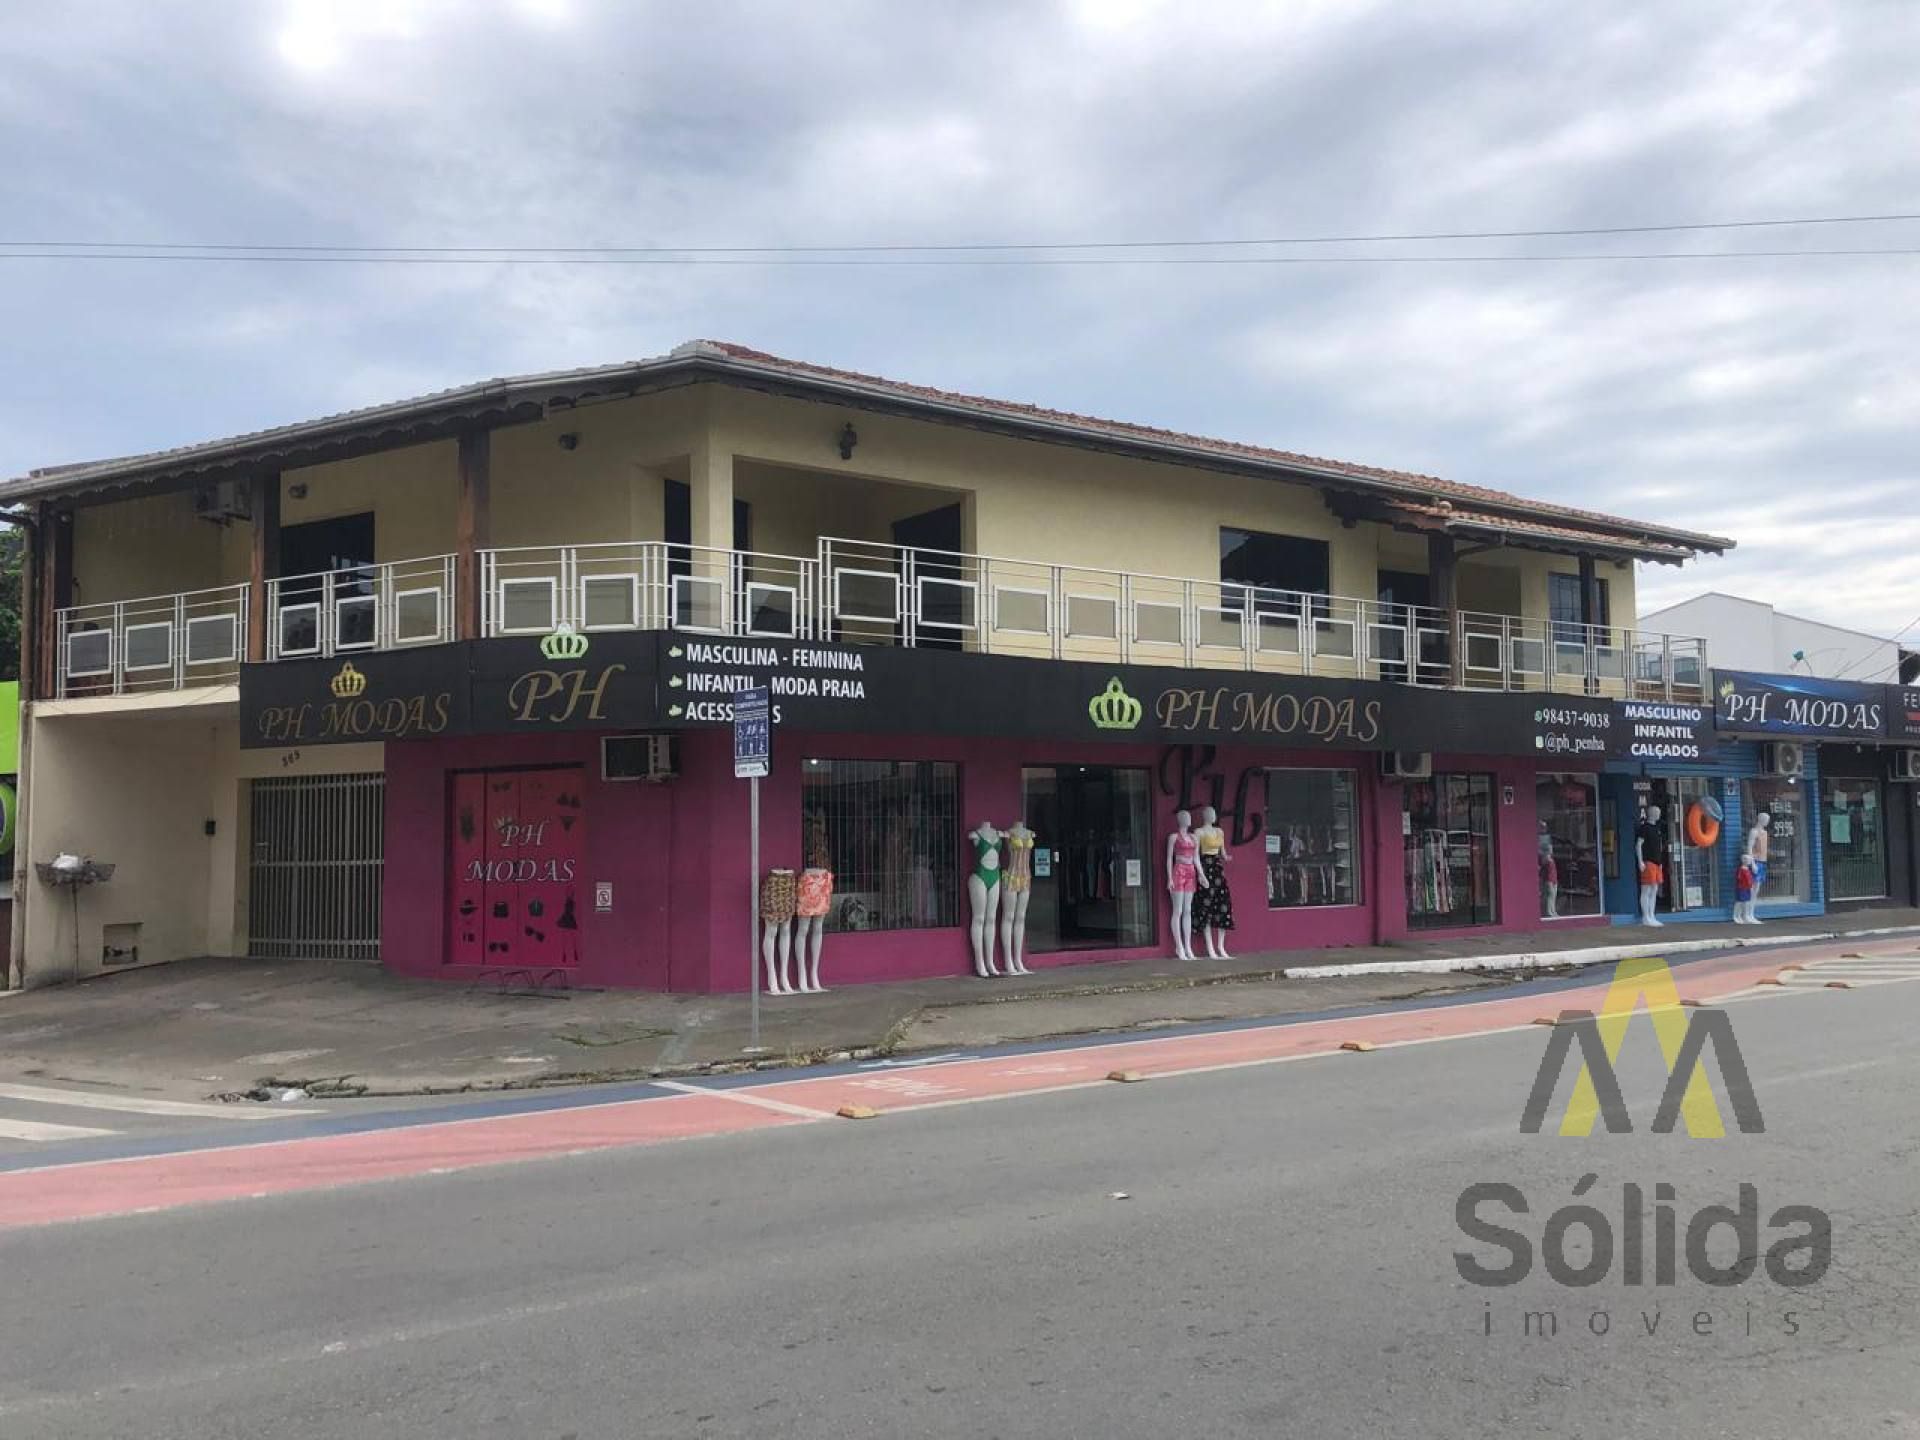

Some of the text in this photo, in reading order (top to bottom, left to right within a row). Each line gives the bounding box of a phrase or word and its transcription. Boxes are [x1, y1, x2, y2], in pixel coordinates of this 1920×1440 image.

[686, 643, 779, 666] MASCULINA
[792, 648, 864, 671] FEMININA
[510, 664, 626, 722] PH
[686, 672, 754, 693] INFANTIL
[771, 676, 818, 697] MODA
[822, 679, 865, 699] PRAIA
[684, 701, 781, 724] ACESSS
[1624, 704, 1702, 721] MASCULINO
[1725, 692, 1881, 730] PH MODAS
[1903, 691, 1920, 709] FE
[258, 692, 451, 740] PH MODAS
[1156, 687, 1381, 742] PH MODAS
[1543, 707, 1611, 729] 98437-9038
[1634, 724, 1695, 739] INFANTIL
[1631, 743, 1699, 760] CALÇADOS
[500, 819, 550, 847] PH
[464, 858, 576, 882] MODAS
